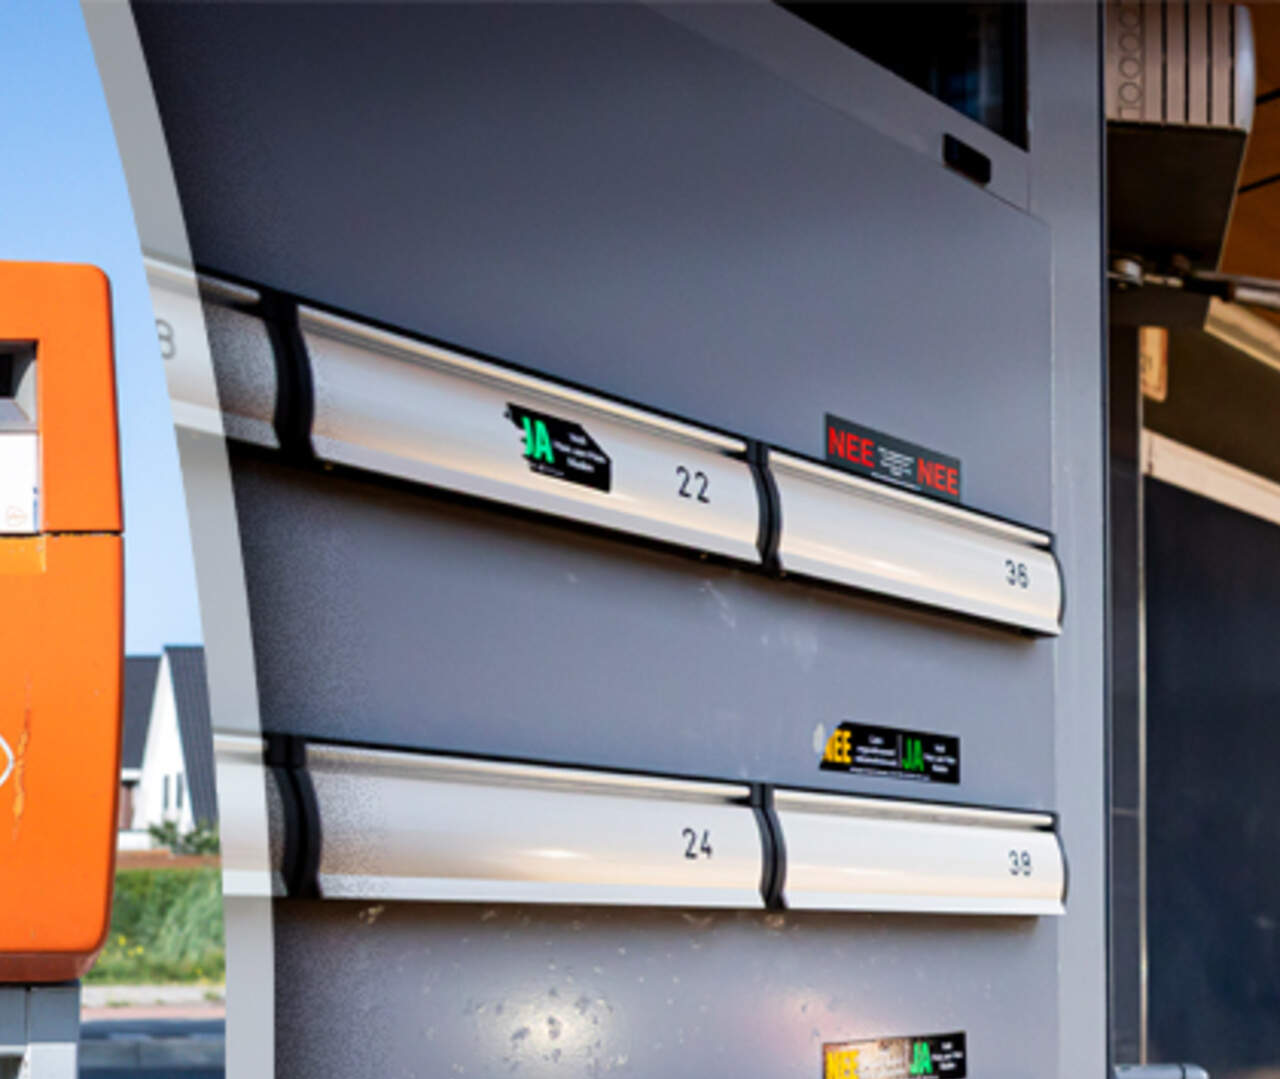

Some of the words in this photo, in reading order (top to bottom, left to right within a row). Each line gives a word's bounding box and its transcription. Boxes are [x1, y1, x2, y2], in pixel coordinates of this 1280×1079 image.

[522, 415, 555, 464] JA
[827, 426, 875, 469] NEE
[676, 464, 711, 504] 22
[916, 457, 959, 496] NEE
[1006, 558, 1030, 590] 36
[901, 736, 925, 773] JA
[681, 827, 713, 860] 24
[1008, 849, 1031, 878] 38
[908, 1041, 934, 1076] JA
